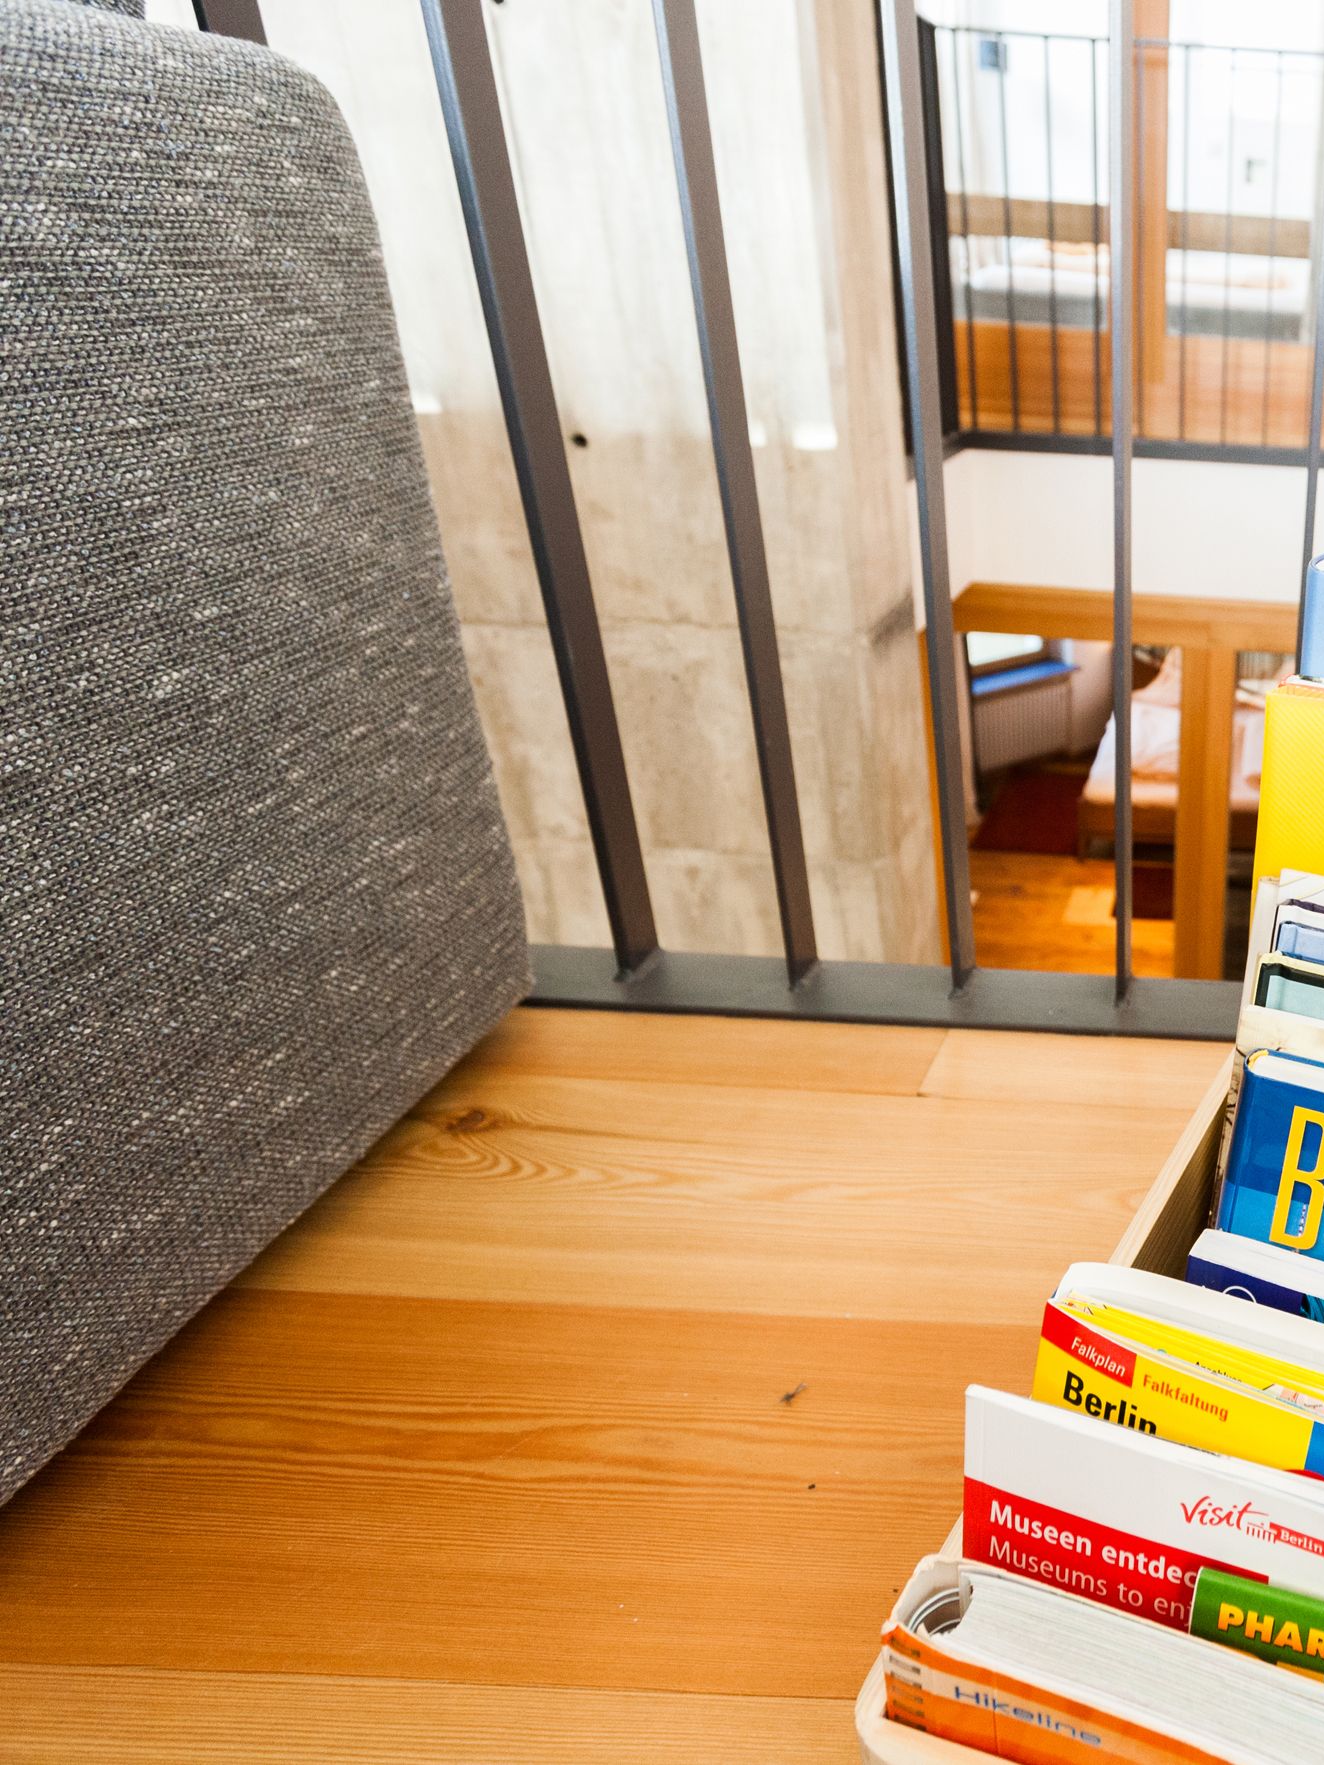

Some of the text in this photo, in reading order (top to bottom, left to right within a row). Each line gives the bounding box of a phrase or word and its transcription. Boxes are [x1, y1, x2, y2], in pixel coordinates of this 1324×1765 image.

[1070, 1336, 1126, 1378] Falkplan
[1143, 1373, 1229, 1422] Falkfaltung
[989, 1499, 1092, 1557] Museen
[1180, 1495, 1324, 1555] Visit Berlin
[989, 1535, 1107, 1596] Museums
[1117, 1581, 1144, 1608] to
